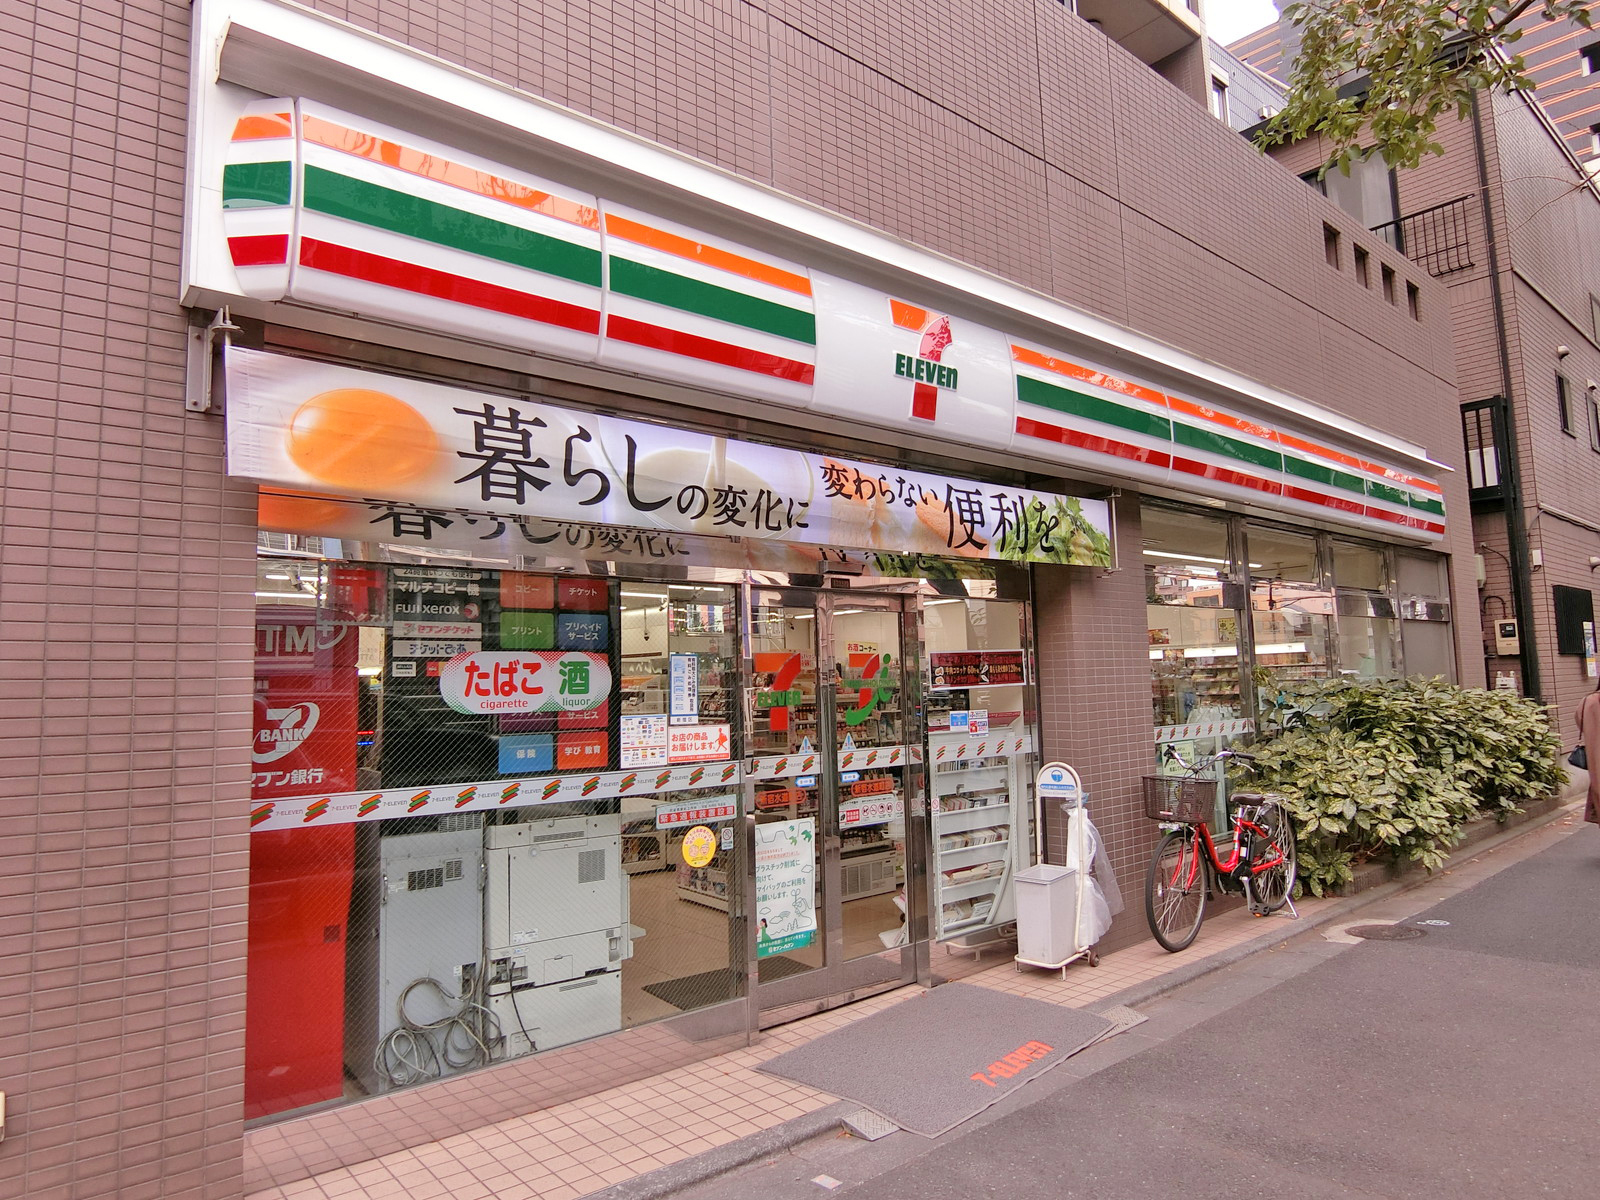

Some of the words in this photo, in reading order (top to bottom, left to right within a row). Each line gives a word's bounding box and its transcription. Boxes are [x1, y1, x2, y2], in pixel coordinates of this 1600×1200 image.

[453, 403, 809, 531] 暮らしの変化に
[819, 464, 1061, 555] 変わらない便利を
[396, 581, 480, 597] マルチコピー機
[515, 585, 540, 594] コピー
[568, 587, 598, 596] チケット
[423, 604, 460, 615] xerox
[418, 624, 474, 635] セブンチケット
[512, 626, 542, 636] プリント
[253, 625, 315, 653] TM
[568, 632, 599, 640] サービス
[464, 660, 544, 698] たばこ
[559, 661, 590, 695] 酒
[480, 699, 528, 710] cigarette
[562, 698, 591, 707] liquor
[260, 728, 306, 742] BANK
[672, 732, 708, 742] お店の商品
[564, 746, 581, 756] 学び
[970, 1040, 1054, 1087] 7-ELEVEN
